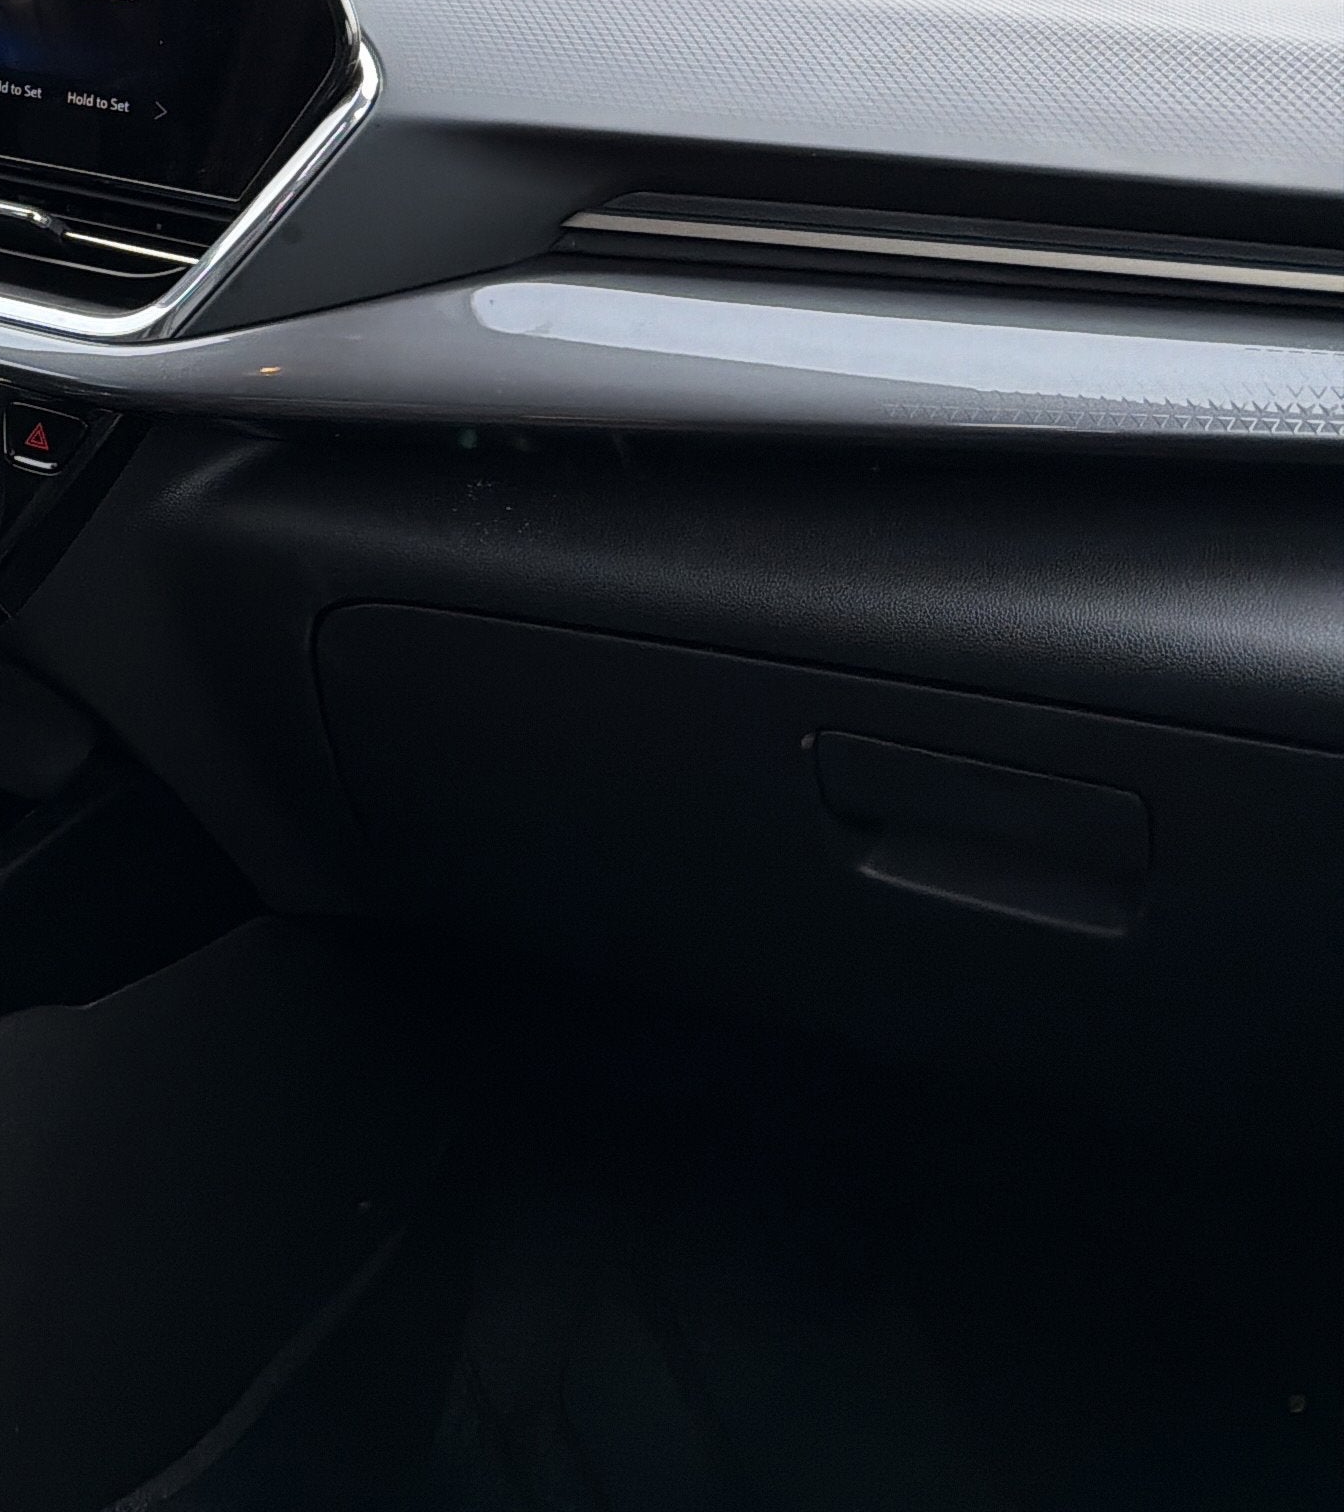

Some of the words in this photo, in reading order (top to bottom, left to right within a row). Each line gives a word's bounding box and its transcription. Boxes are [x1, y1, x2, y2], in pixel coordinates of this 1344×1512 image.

[10, 84, 23, 97] to
[24, 85, 43, 100] Set
[67, 91, 94, 108] Hold
[96, 97, 109, 110] to
[110, 98, 131, 113] Set
